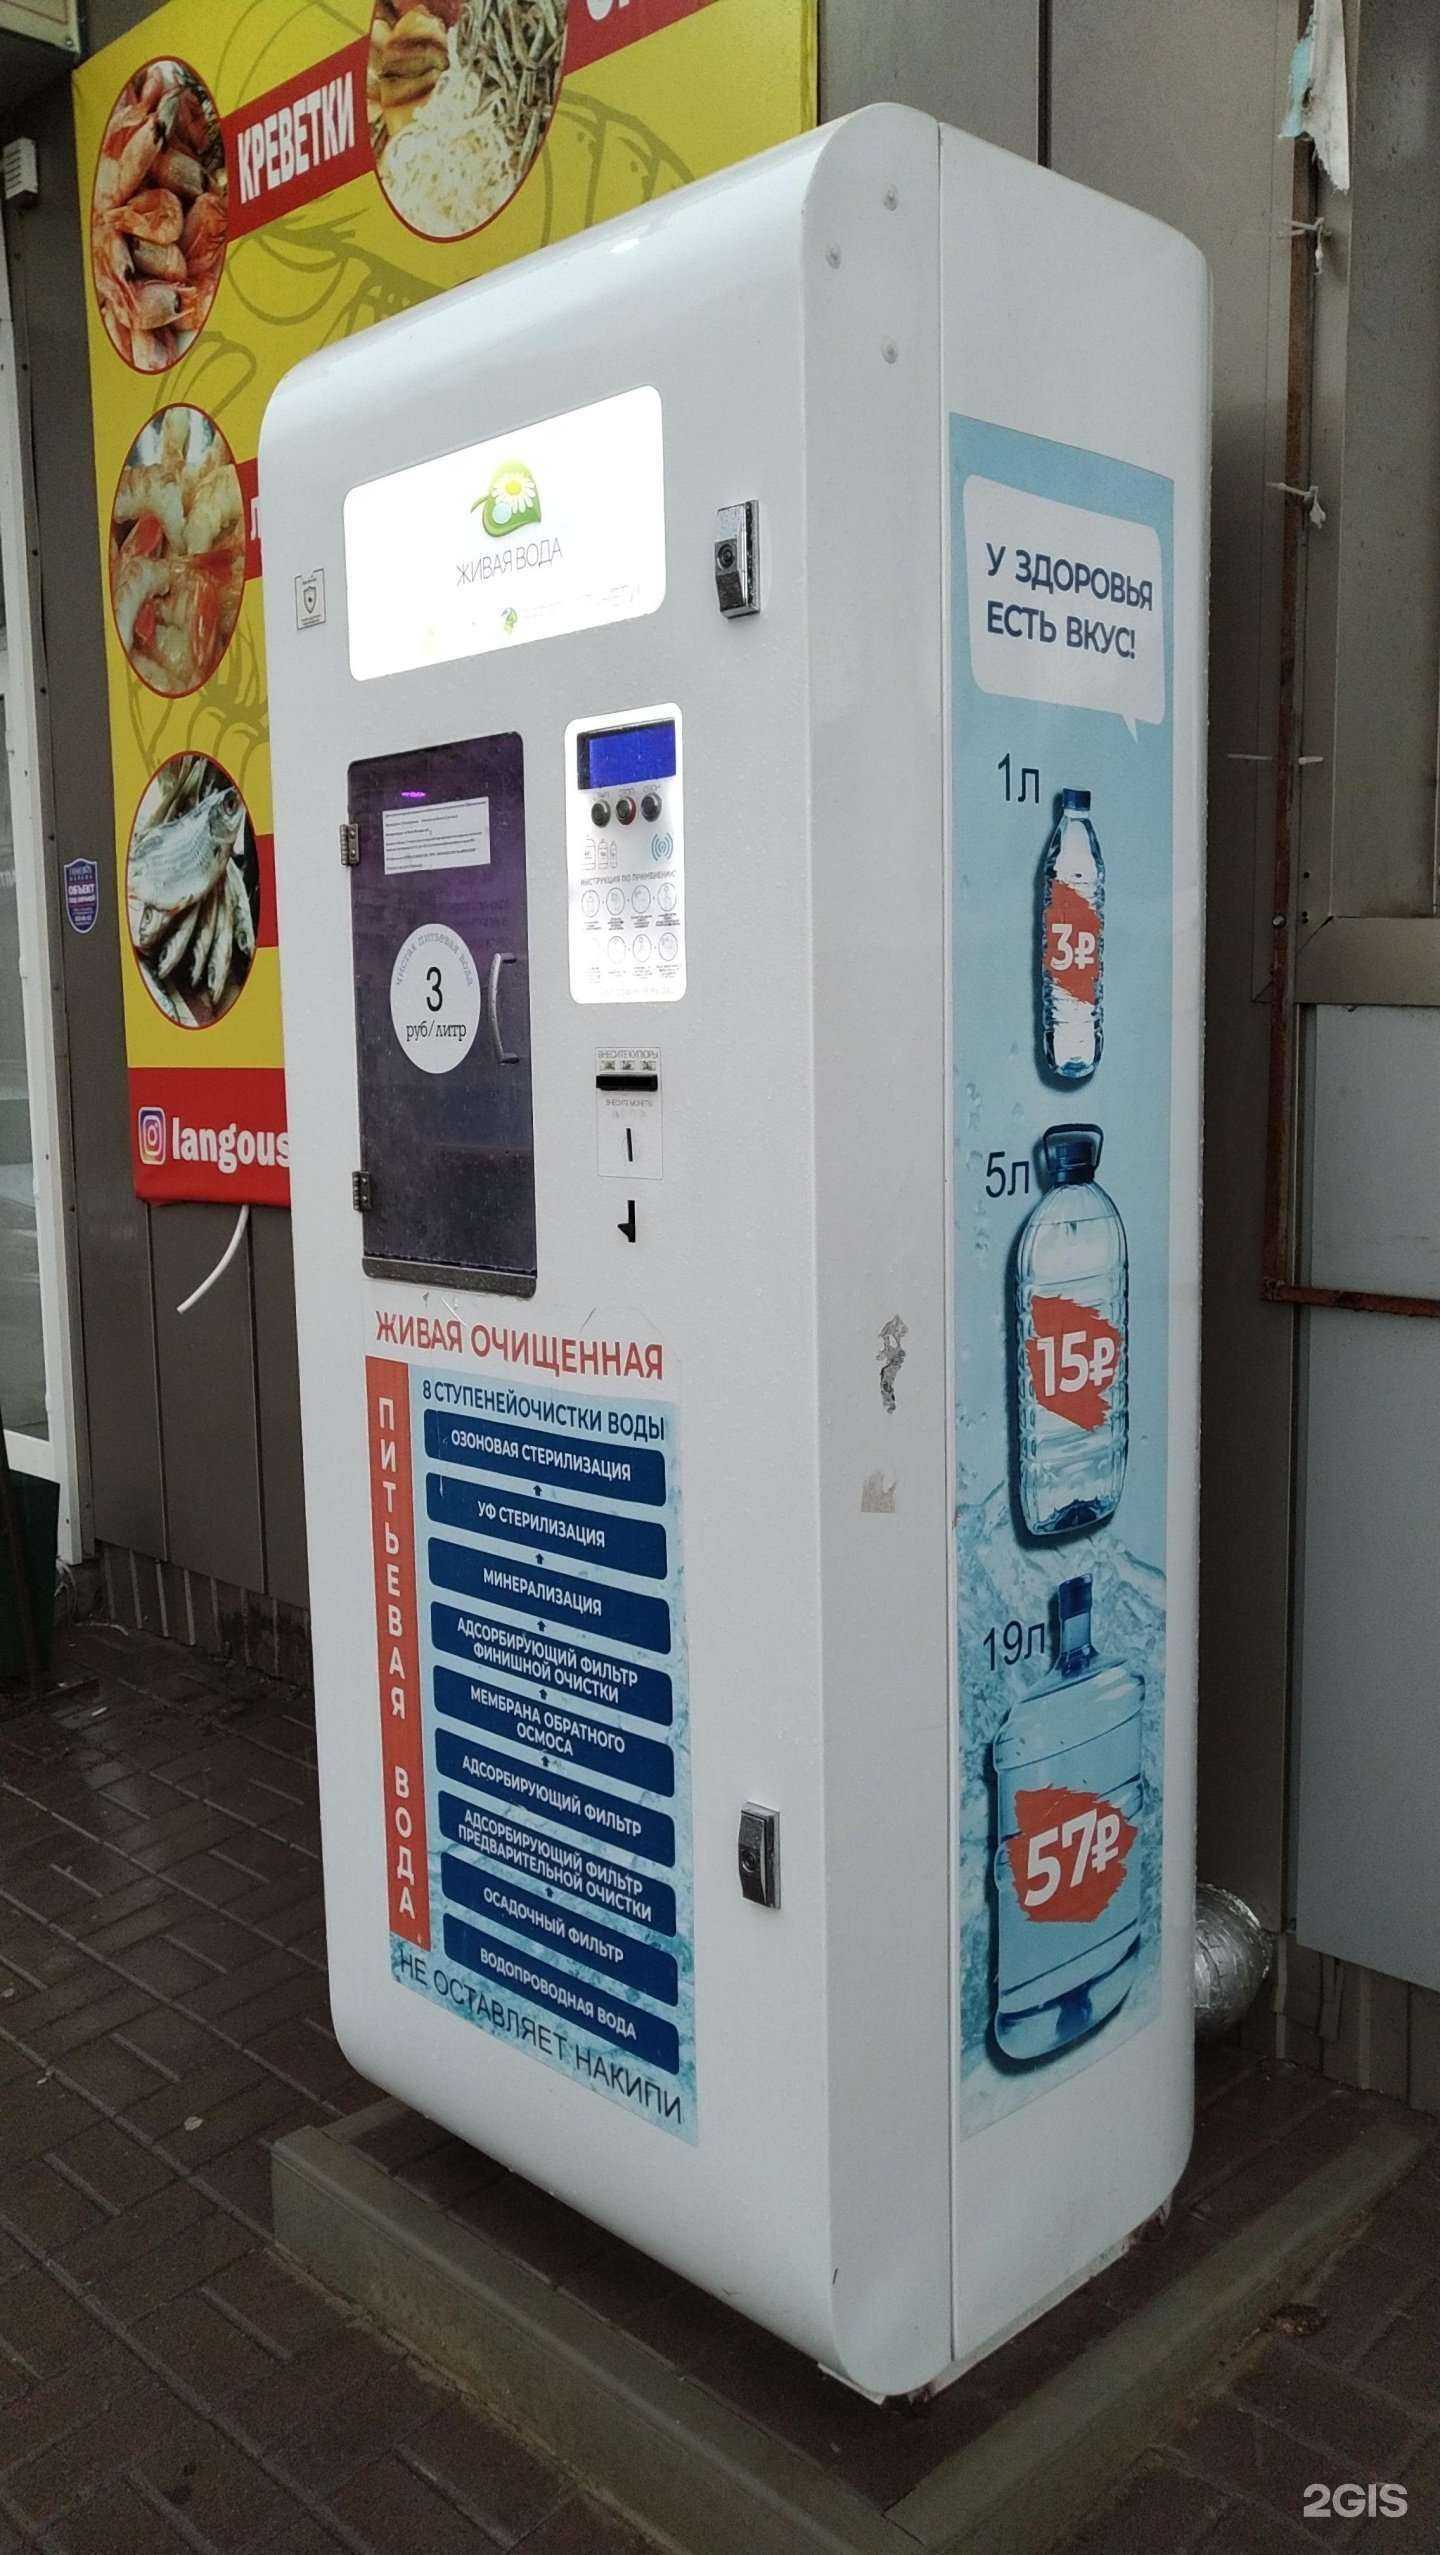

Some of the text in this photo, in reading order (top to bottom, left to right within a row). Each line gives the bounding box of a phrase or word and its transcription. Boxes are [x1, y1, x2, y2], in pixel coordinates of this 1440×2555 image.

[237, 71, 355, 205] КРЕВЕТКИ
[456, 537, 562, 586] ЖИВАЯ ВОДА
[986, 542, 1153, 611] У ЗДОРОВЬЯ
[987, 600, 1136, 660] ЕСТЬ ВКУС!
[998, 753, 1040, 804] 1л
[426, 966, 443, 1012] 3
[406, 1020, 467, 1042] руб/литр
[985, 1151, 1030, 1198] 5л
[376, 1310, 664, 1380] ЖИВАЯ ОЧИЩЕННАЯ
[422, 1380, 432, 1400] 8
[608, 1411, 665, 1442] ВОДЫ
[451, 1429, 631, 1482] ОЗОНОВАЯ СТЕРИЛИЗАЦИЯ
[477, 1500, 605, 1548] УФ СТЕРИЛИЗАЦИЯ
[378, 1396, 406, 1720] ПИТЬЕВАЯ
[483, 1567, 602, 1617] МИНЕРАЛИЗАЦИЯ
[457, 1617, 638, 1688] АДСОРБИРУЮЩИЙ ФИЛЬТР
[473, 1642, 619, 1704] ФИНИШНОЙ ОЧИСТКИ
[982, 1620, 1045, 1671] 19л
[470, 1685, 625, 1753] МЕМБРАНА ОБРАТНОГО
[516, 1722, 573, 1756] ОСМОСА
[462, 1755, 642, 1837] АДСОРБИРУЮЩИЙ ФИЛЬТР
[394, 1766, 415, 1920] ВОДА
[458, 1824, 652, 1922] ПРЕДВАРИТЕЛЬНОЙ ОЧИСТКИ
[464, 1809, 643, 1895] АДСОРБИРУЮЩИЙ ФИЛЬТР
[484, 1887, 624, 1964] ОСАДОЧНЫЙ ФИЛЬТР
[480, 1948, 637, 2040] ВОДОПРОВОДНАЯ ВОДА
[400, 1950, 682, 2124] НЕ ОСТАВЛЯЕТ НАКИПИ
